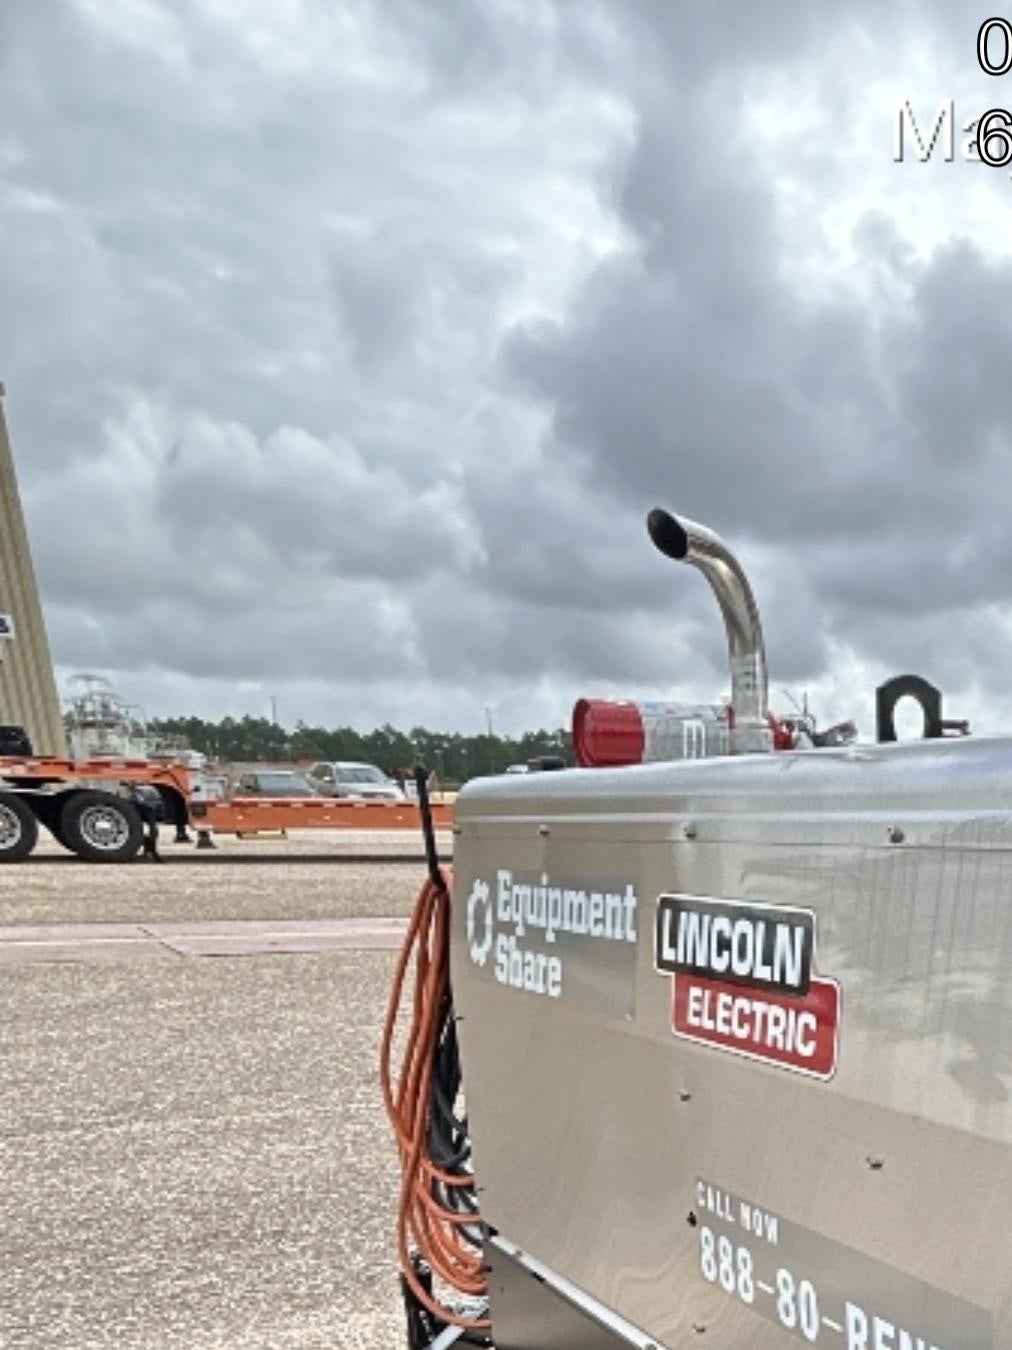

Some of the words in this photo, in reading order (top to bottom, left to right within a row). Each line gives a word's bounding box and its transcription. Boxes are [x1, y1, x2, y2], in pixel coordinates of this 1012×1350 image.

[497, 869, 637, 943] Equipment
[494, 931, 562, 998] Share
[662, 908, 805, 986] LINCOLN
[687, 986, 817, 1057] ELECTRIC
[698, 1181, 735, 1223] CALL
[740, 1202, 779, 1245] NOW
